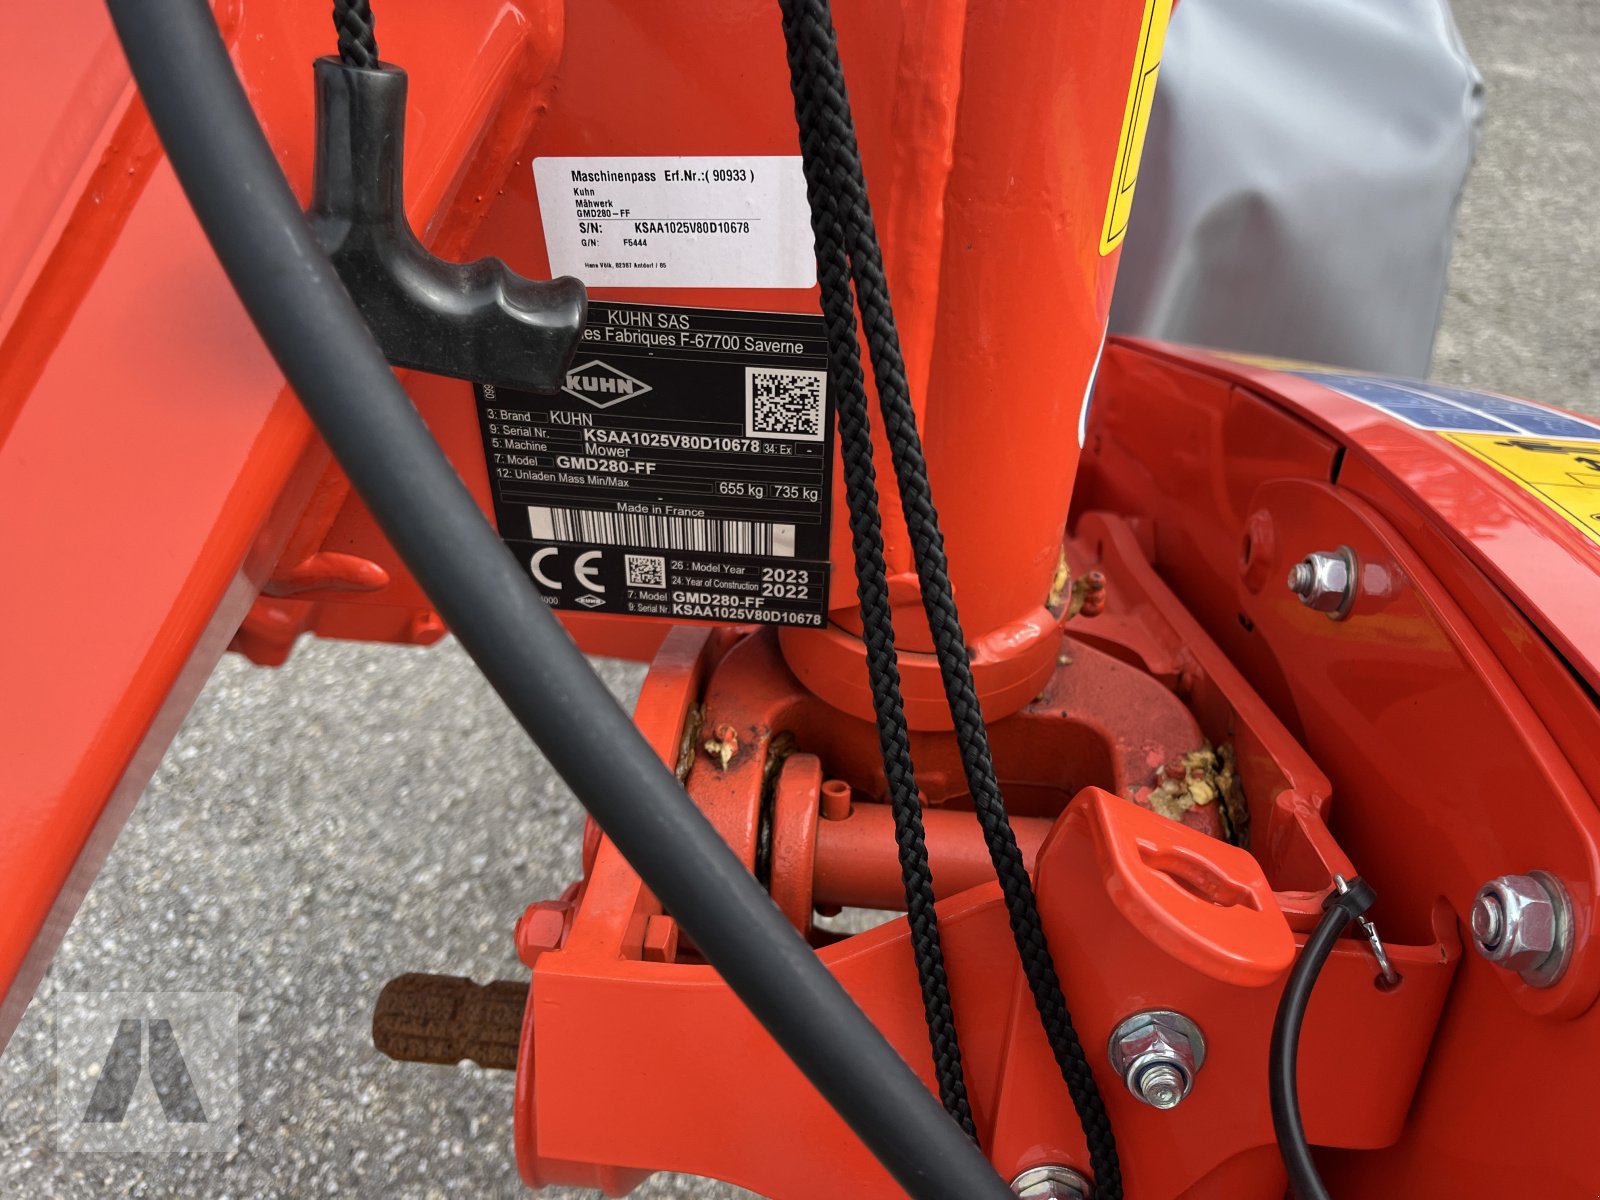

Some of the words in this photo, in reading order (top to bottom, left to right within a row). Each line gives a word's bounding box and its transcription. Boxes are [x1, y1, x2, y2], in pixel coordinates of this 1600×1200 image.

[571, 170, 656, 183] Maschinenpass
[573, 188, 595, 196] Kuhn
[579, 222, 603, 234] S/N:
[634, 222, 750, 234] KSAA1025V80D10678
[581, 238, 600, 246] G/N:
[623, 238, 648, 246] F5444
[608, 310, 652, 327] KUHN
[658, 313, 690, 330] SAS
[581, 328, 601, 340] es
[605, 327, 676, 348] Fabriques
[680, 332, 740, 350] F-67700
[744, 336, 804, 354] Saverne
[566, 376, 634, 394] KUHN
[487, 408, 497, 419] 3:
[500, 410, 531, 422] Brand
[550, 410, 592, 426] KUHN
[490, 424, 500, 434] 9:
[502, 425, 532, 437] Serial
[534, 428, 550, 438] Nr.
[584, 428, 760, 452] KSAA1025V80D10678
[764, 444, 778, 454] 34:
[780, 444, 792, 454] Ex
[492, 438, 502, 448] 5:
[504, 439, 548, 452] Machine
[584, 442, 630, 458] Mower
[494, 454, 504, 464] 7:
[507, 454, 538, 466] Model
[556, 456, 656, 475] GMD280-FF
[497, 468, 512, 478] 12:
[515, 470, 556, 482] Unladen
[559, 472, 584, 484] Mass
[588, 474, 630, 488] Min/Max
[720, 482, 744, 495] 655
[748, 484, 763, 499] kg
[774, 486, 798, 498] 735
[803, 488, 818, 502] kg
[617, 502, 648, 514] Made
[652, 504, 662, 514] in
[665, 505, 705, 518] France
[672, 560, 684, 570] 26
[692, 562, 720, 572] Model
[723, 564, 746, 574] Year
[762, 568, 809, 584] 2023
[672, 576, 684, 585] 24:
[686, 577, 702, 586] Year
[704, 578, 712, 587] of
[713, 579, 759, 591] Construction
[762, 583, 808, 599] 2022
[628, 590, 638, 600] 7:
[640, 591, 668, 601] Model
[672, 591, 765, 608] GMD280-FF
[628, 602, 637, 611] 9:
[638, 603, 658, 612] Serial
[660, 604, 669, 614] Nr.
[673, 604, 822, 625] KSAA1025V80D10678
